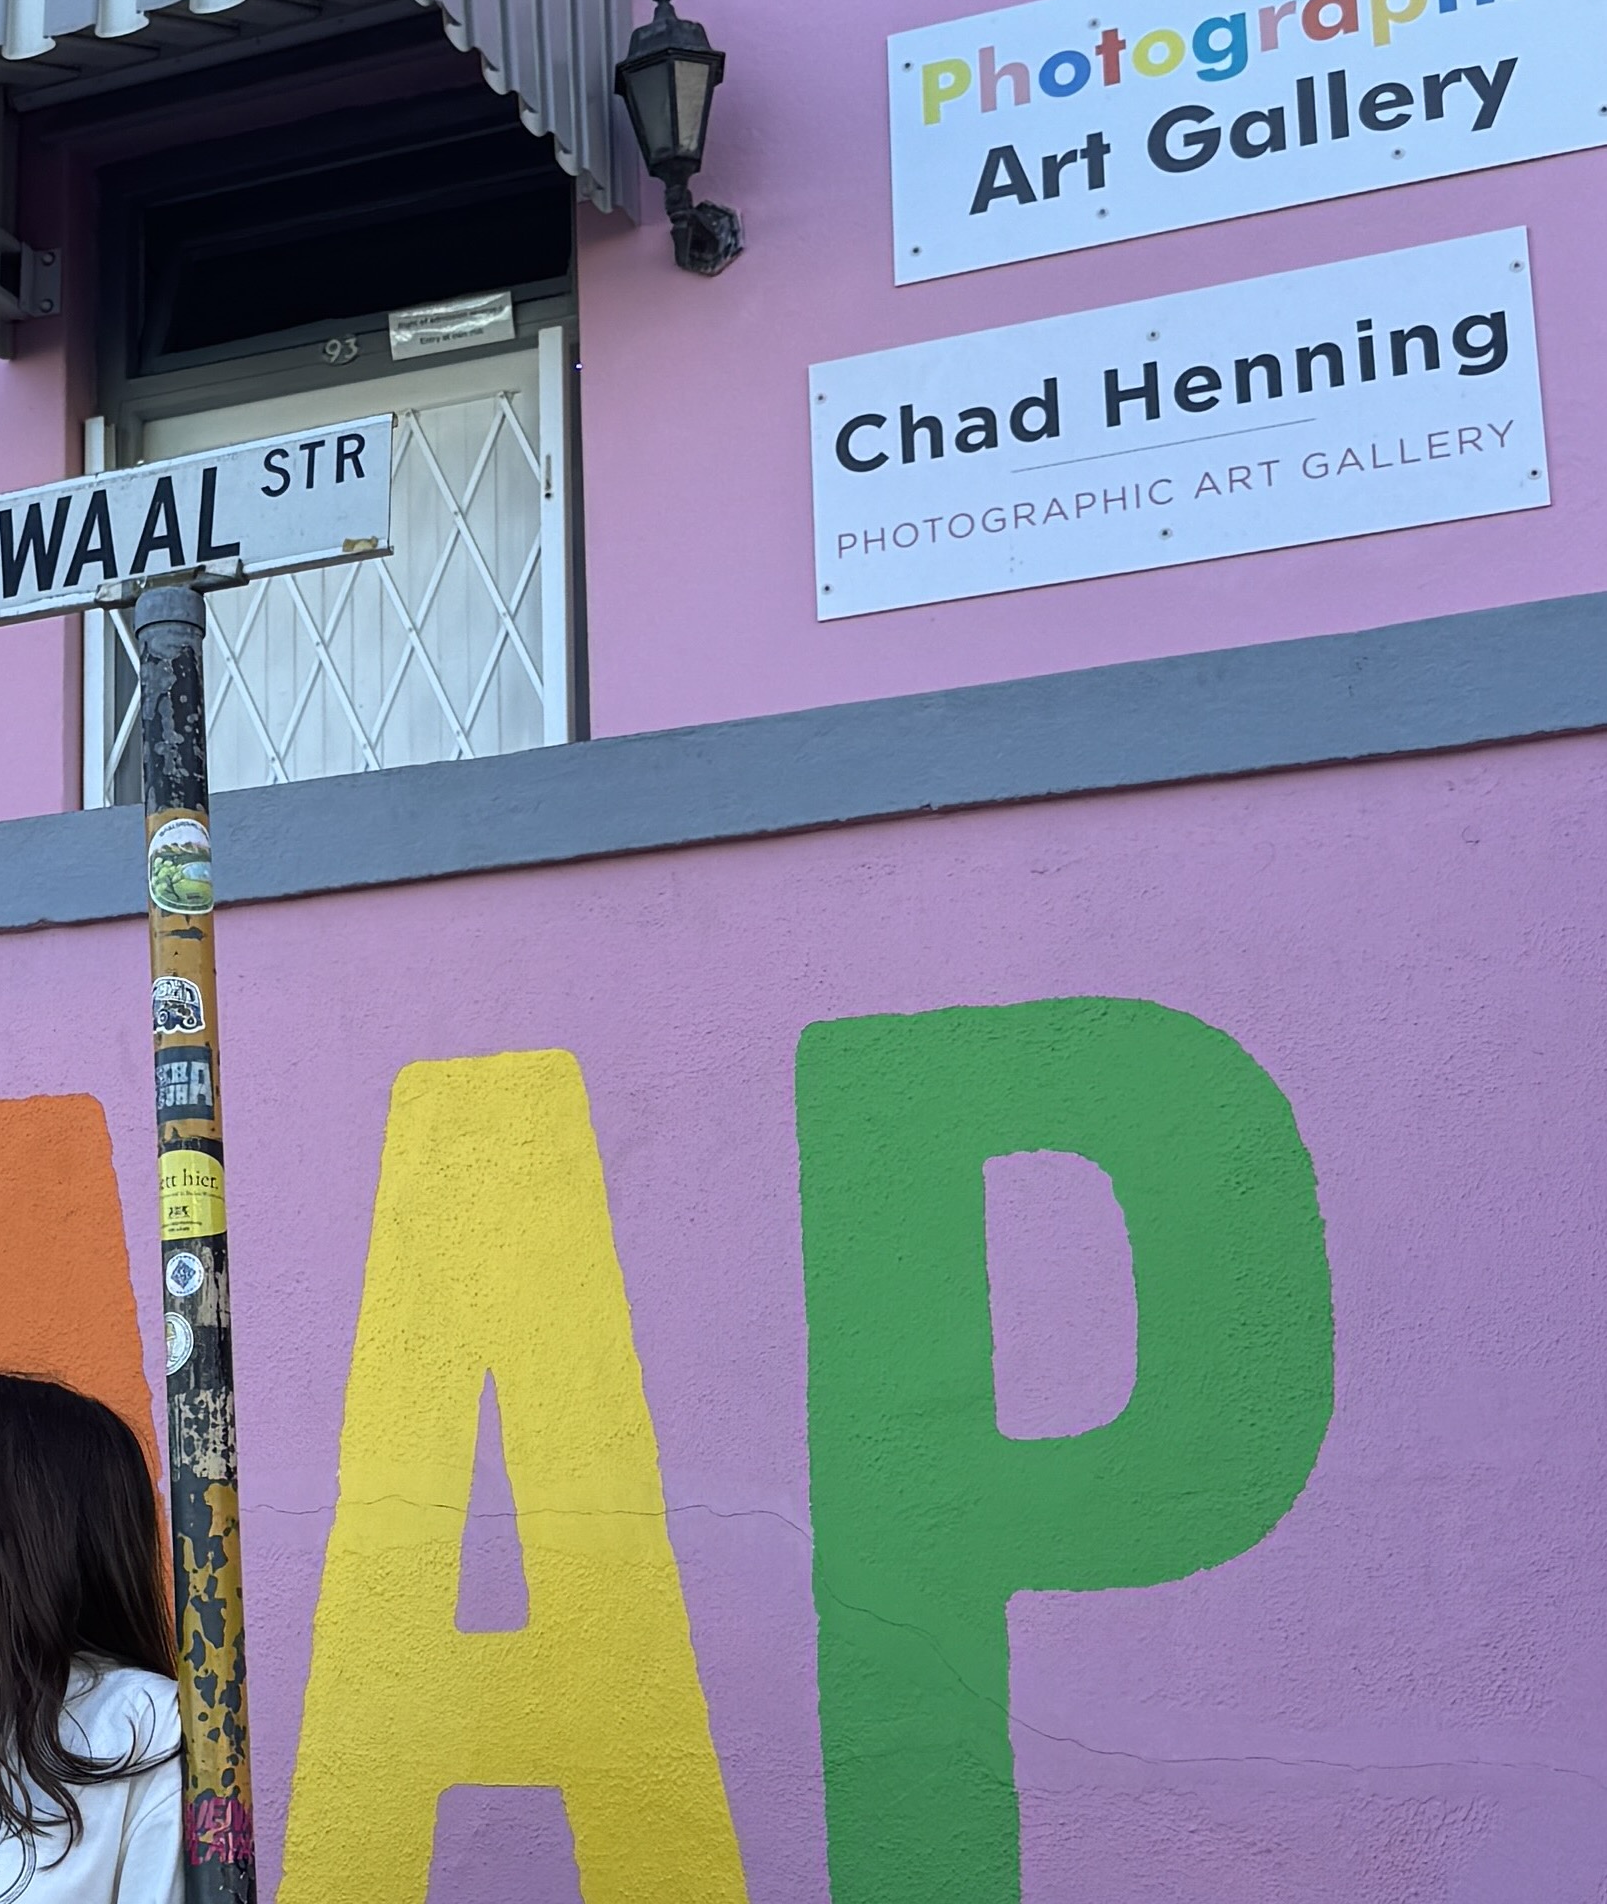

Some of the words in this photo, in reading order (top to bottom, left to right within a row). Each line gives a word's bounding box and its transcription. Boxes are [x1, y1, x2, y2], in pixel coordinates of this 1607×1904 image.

[969, 131, 1111, 215] Art
[1147, 57, 1519, 174] Gallery
[324, 337, 358, 364] 93
[835, 377, 1061, 474] Chad
[1104, 310, 1508, 428] Henning
[261, 433, 365, 498] STR
[837, 478, 1174, 559] PHOTOGRAPHIC
[1194, 459, 1280, 499] ART
[1302, 418, 1515, 480] GALLERY
